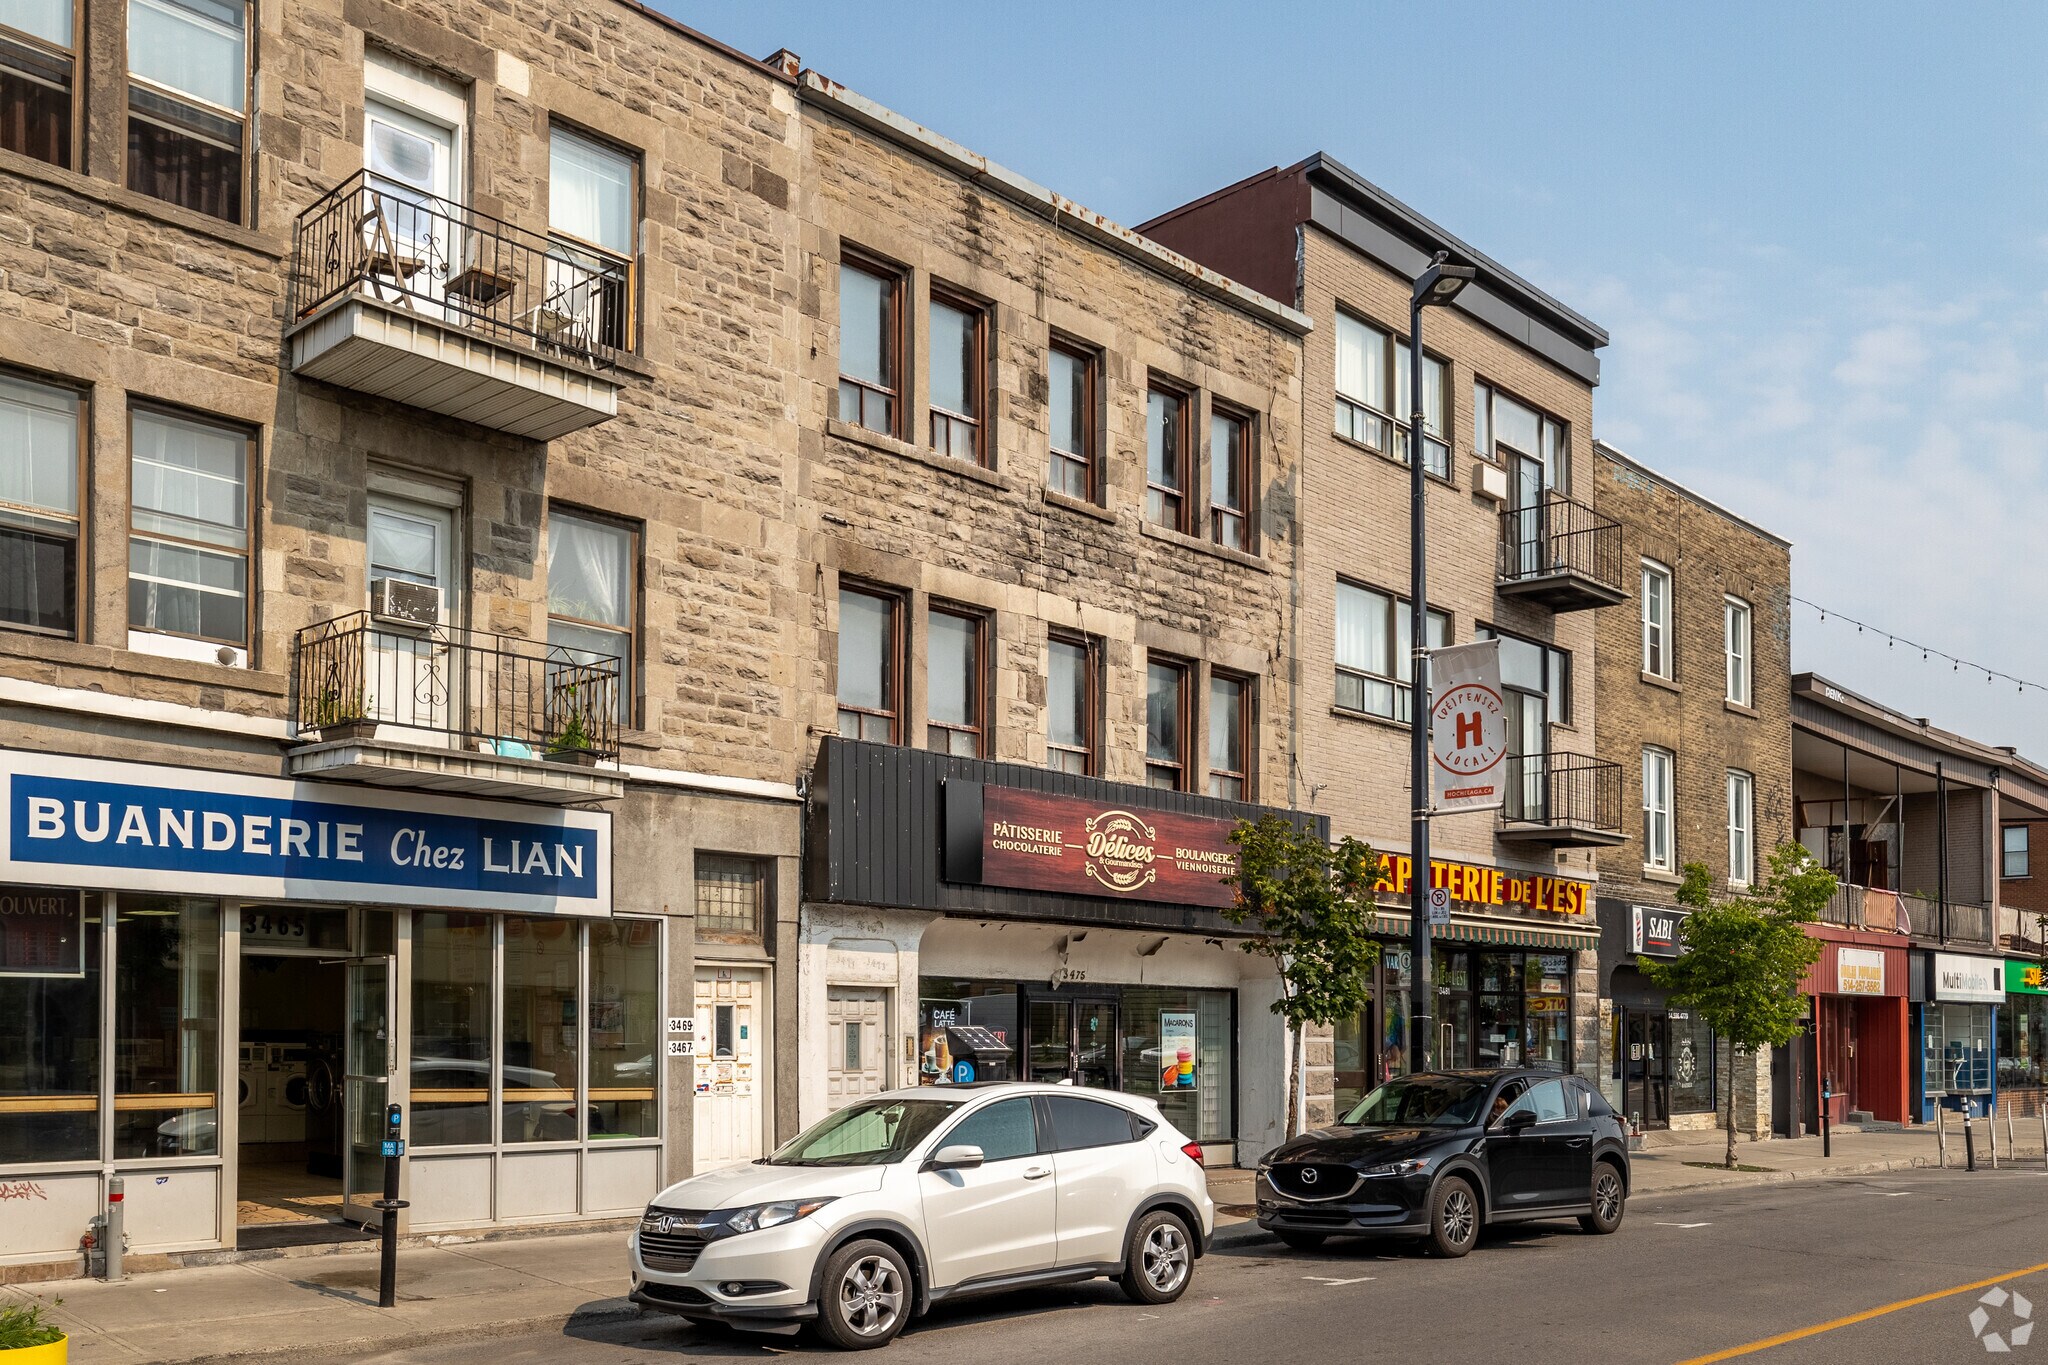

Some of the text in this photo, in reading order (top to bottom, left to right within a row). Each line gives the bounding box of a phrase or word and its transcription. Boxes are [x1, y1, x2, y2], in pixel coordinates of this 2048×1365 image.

[1456, 711, 1483, 750] H
[27, 796, 584, 878] BUANDERIE Chez LIAN
[993, 820, 1063, 844] PÂTISSERIE
[992, 839, 1063, 857] CHOCOLATERIE
[1086, 831, 1156, 864] Délices
[1175, 860, 1236, 876] VIENNOISERIE
[1361, 853, 1592, 916] APTERIE DE L'EST
[0, 896, 66, 915] OUVERT
[244, 914, 305, 937] 3465
[1648, 917, 1674, 940] SABI
[1063, 970, 1086, 981] 3475
[933, 1008, 956, 1020] CAFÉ
[1164, 1018, 1194, 1028] MACARONS
[671, 1020, 692, 1030] 3469
[934, 1020, 955, 1028] LATTE
[671, 1042, 692, 1053] 3467
